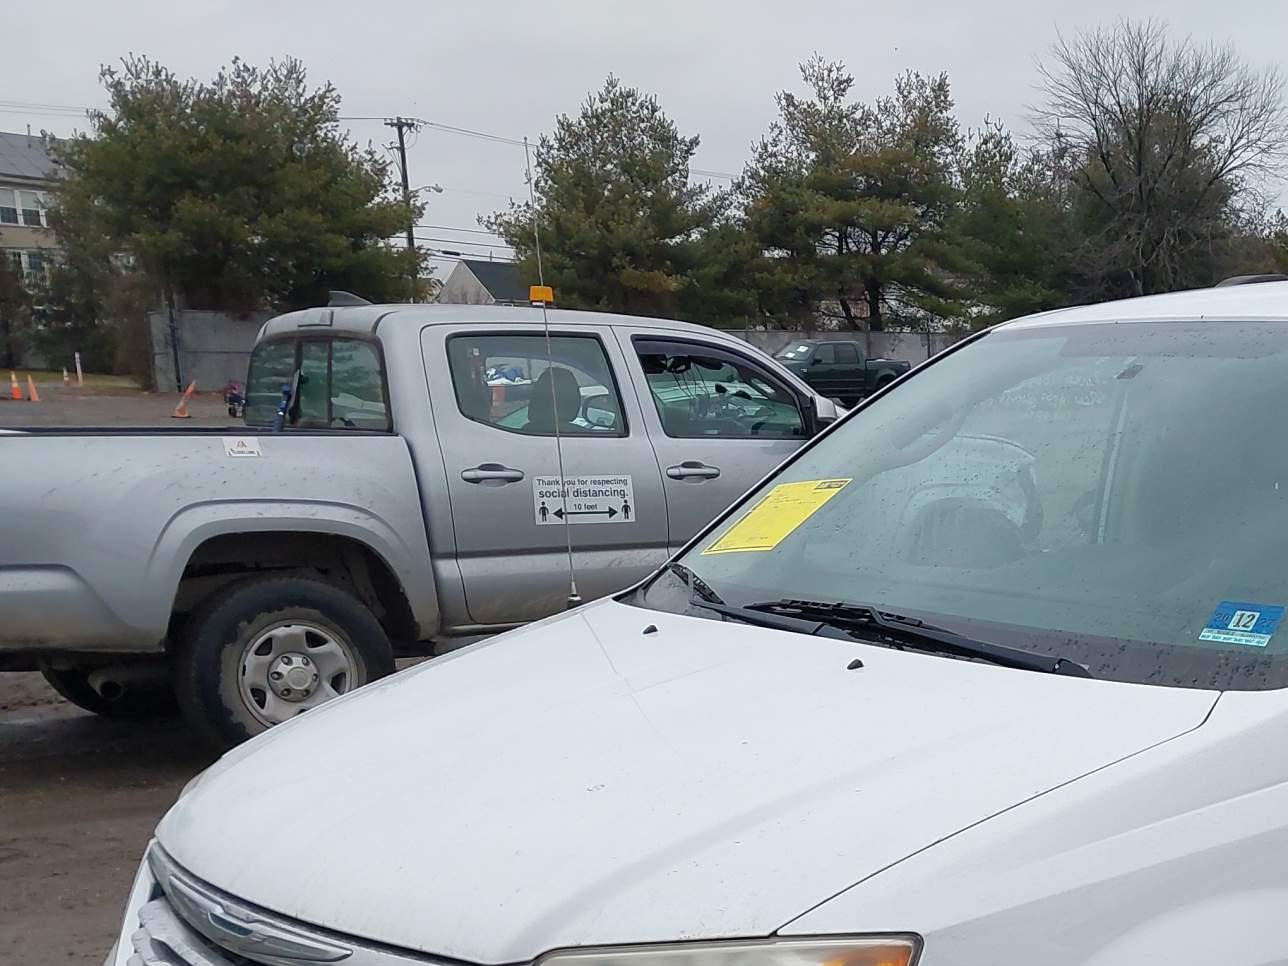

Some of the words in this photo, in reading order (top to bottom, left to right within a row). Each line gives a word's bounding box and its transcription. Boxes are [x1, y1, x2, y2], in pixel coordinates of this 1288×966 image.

[536, 478, 560, 486] Thank
[562, 479, 576, 487] you
[577, 478, 588, 486] for
[590, 478, 628, 487] respecting
[539, 488, 570, 498] social
[572, 487, 629, 499] distancing.
[1233, 612, 1256, 628] 12
